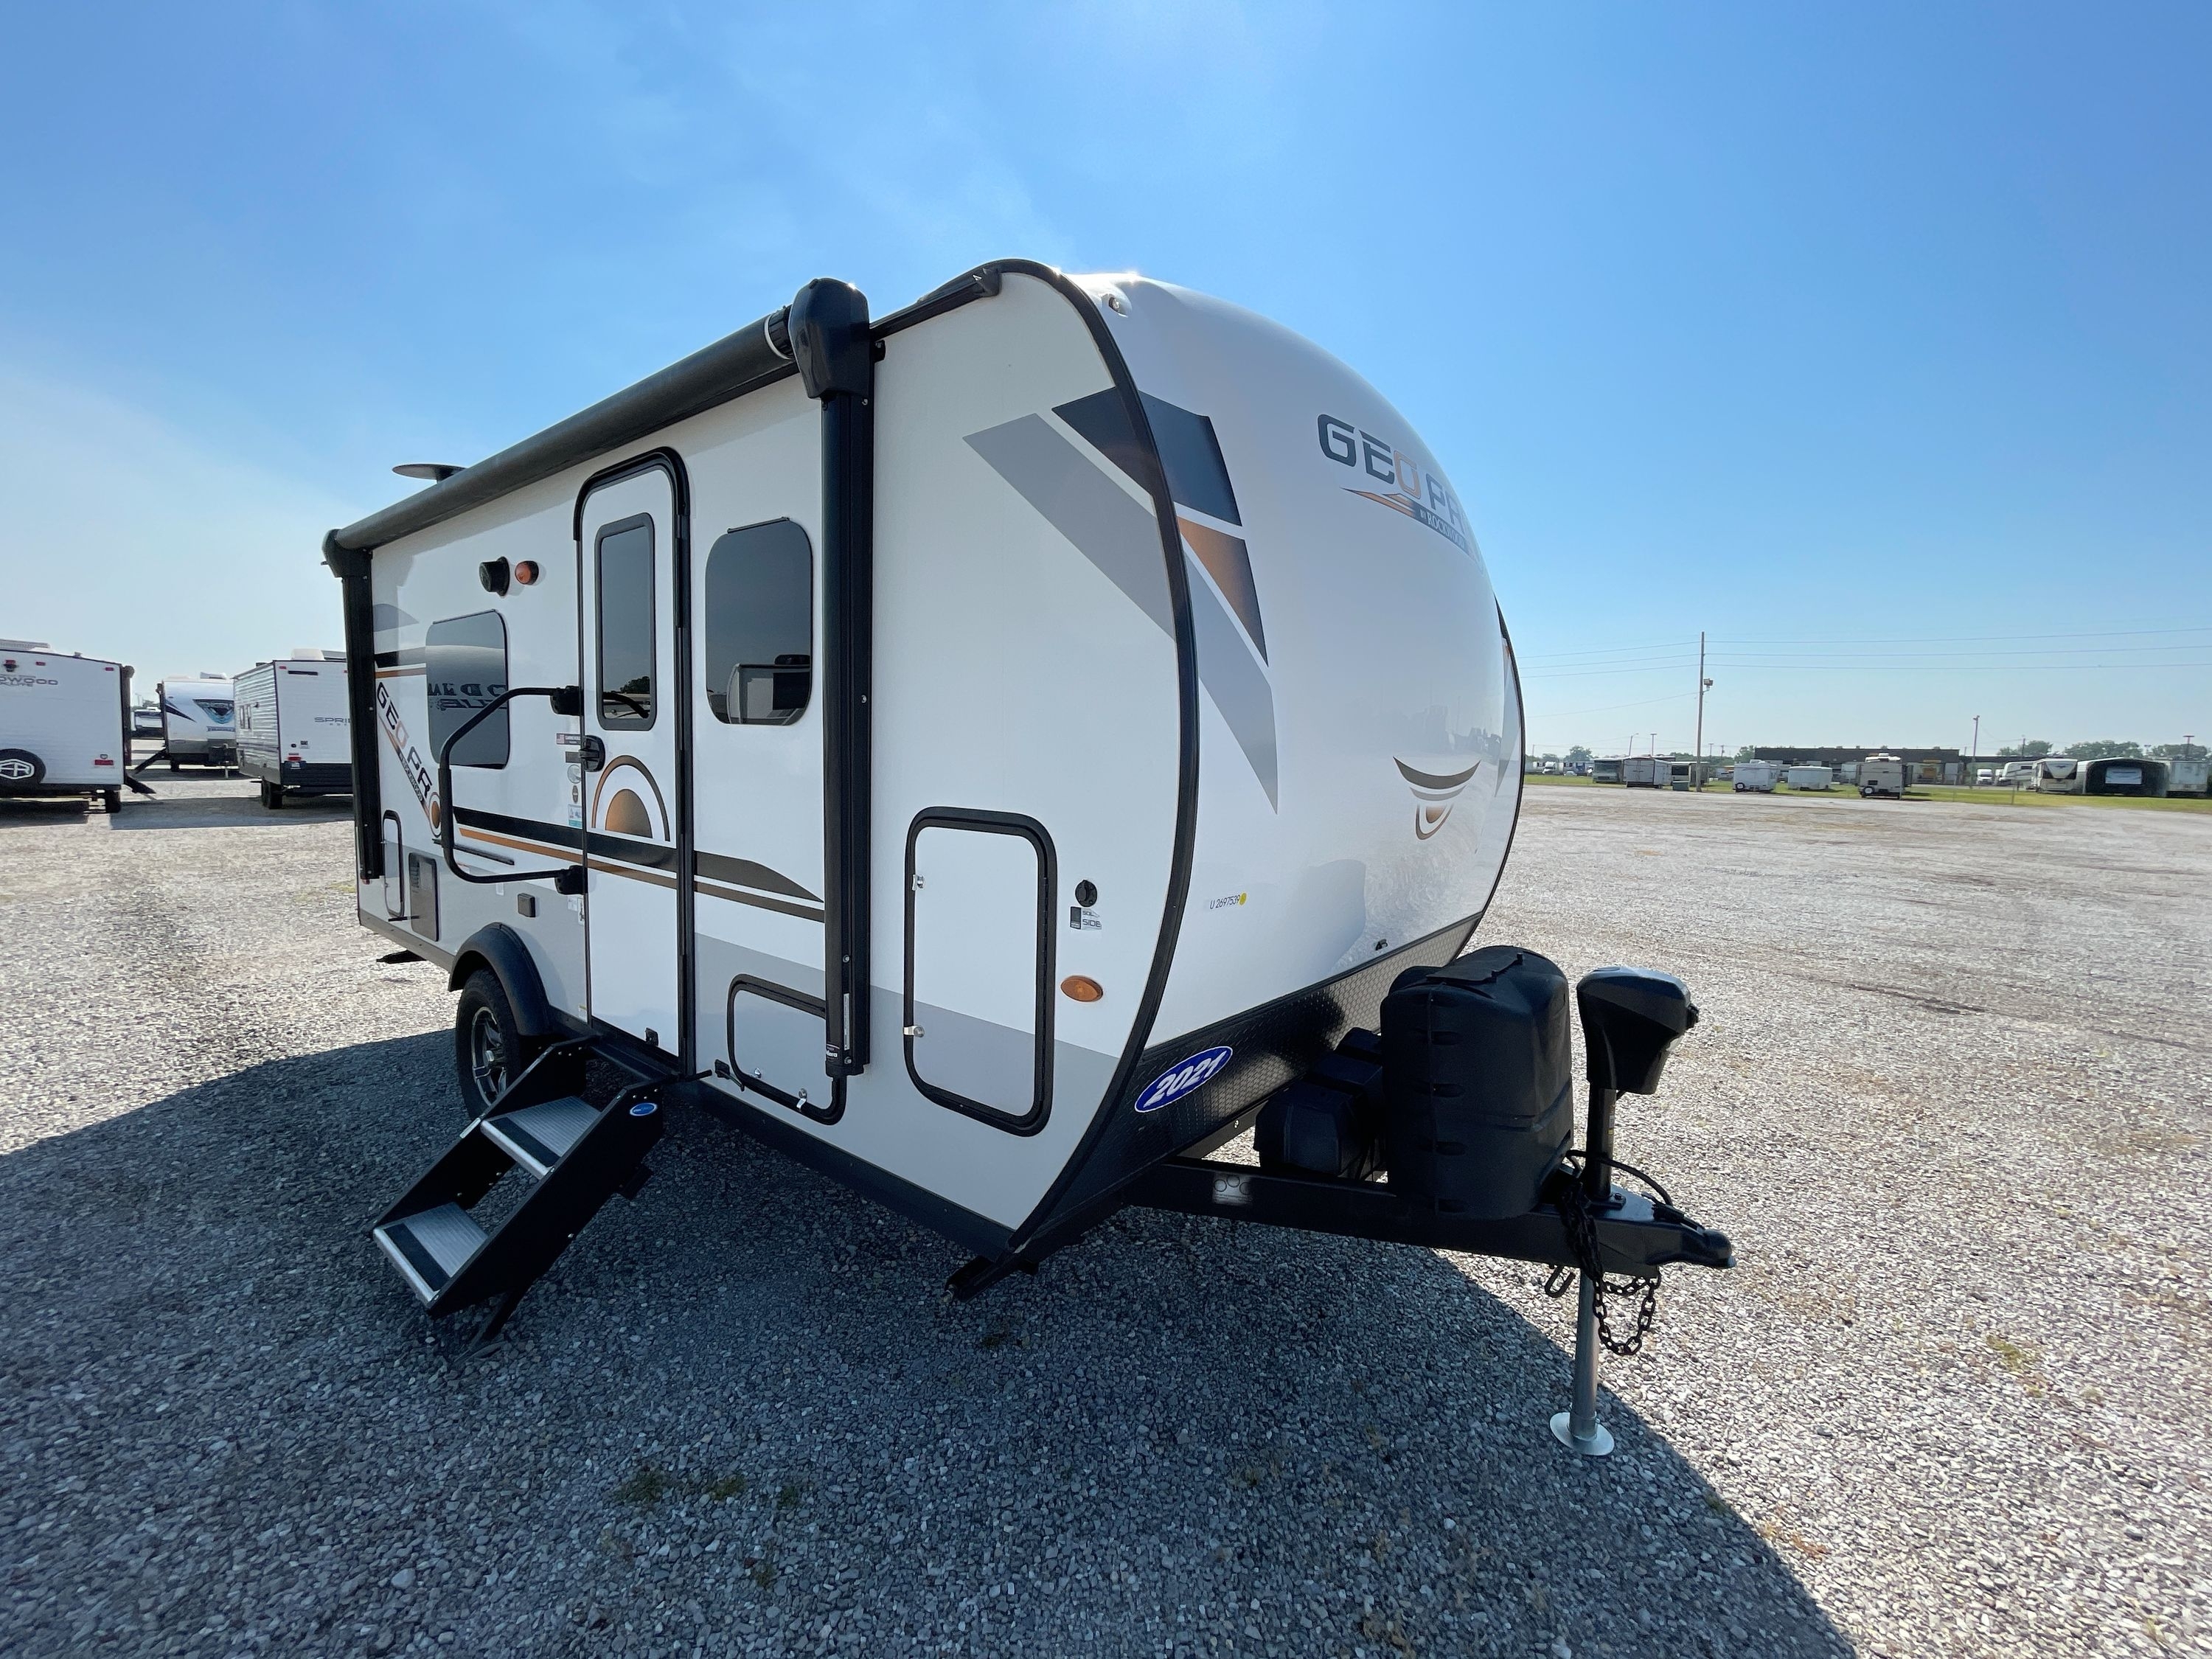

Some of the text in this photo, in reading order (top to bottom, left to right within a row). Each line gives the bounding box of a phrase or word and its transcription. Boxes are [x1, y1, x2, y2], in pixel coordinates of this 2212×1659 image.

[1318, 414, 1421, 499] GEO
[377, 682, 409, 750] GEO
[1082, 919, 1101, 927] SIDE
[1143, 1051, 1227, 1107] 2021
